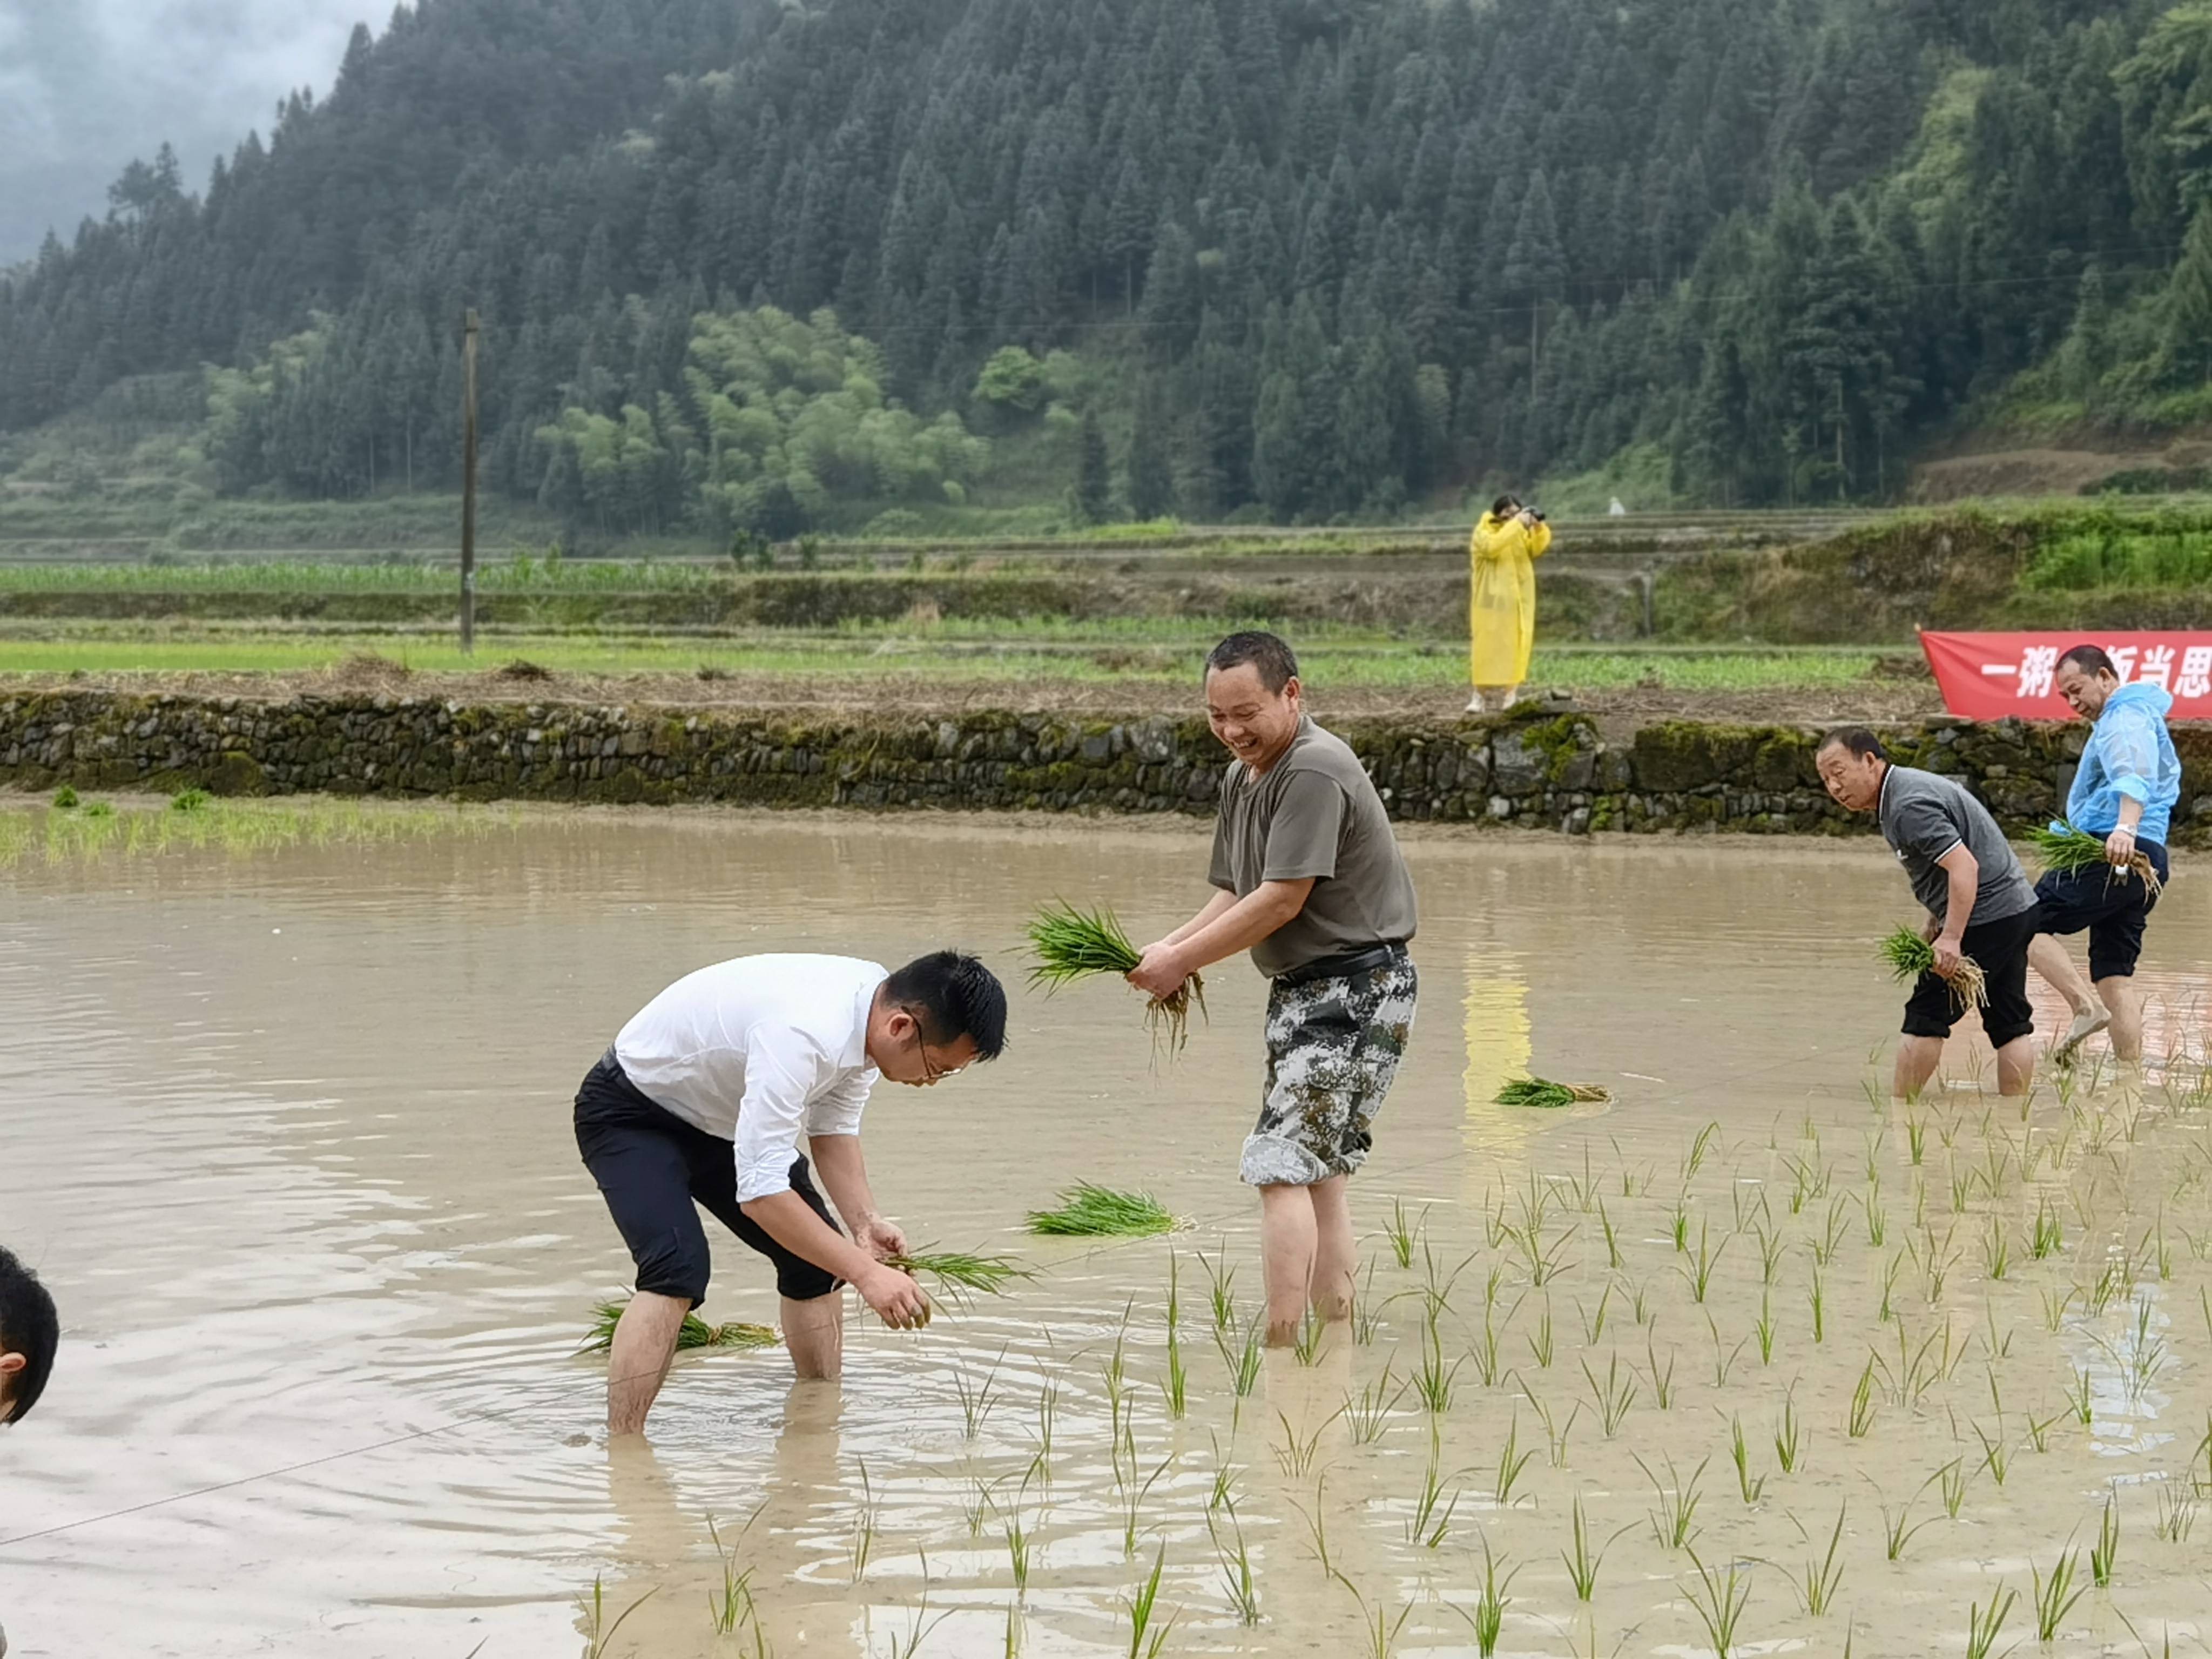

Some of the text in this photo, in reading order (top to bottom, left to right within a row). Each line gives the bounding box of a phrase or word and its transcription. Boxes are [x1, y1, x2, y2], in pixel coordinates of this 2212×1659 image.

[1981, 645, 2212, 698] 一粥饭当思
